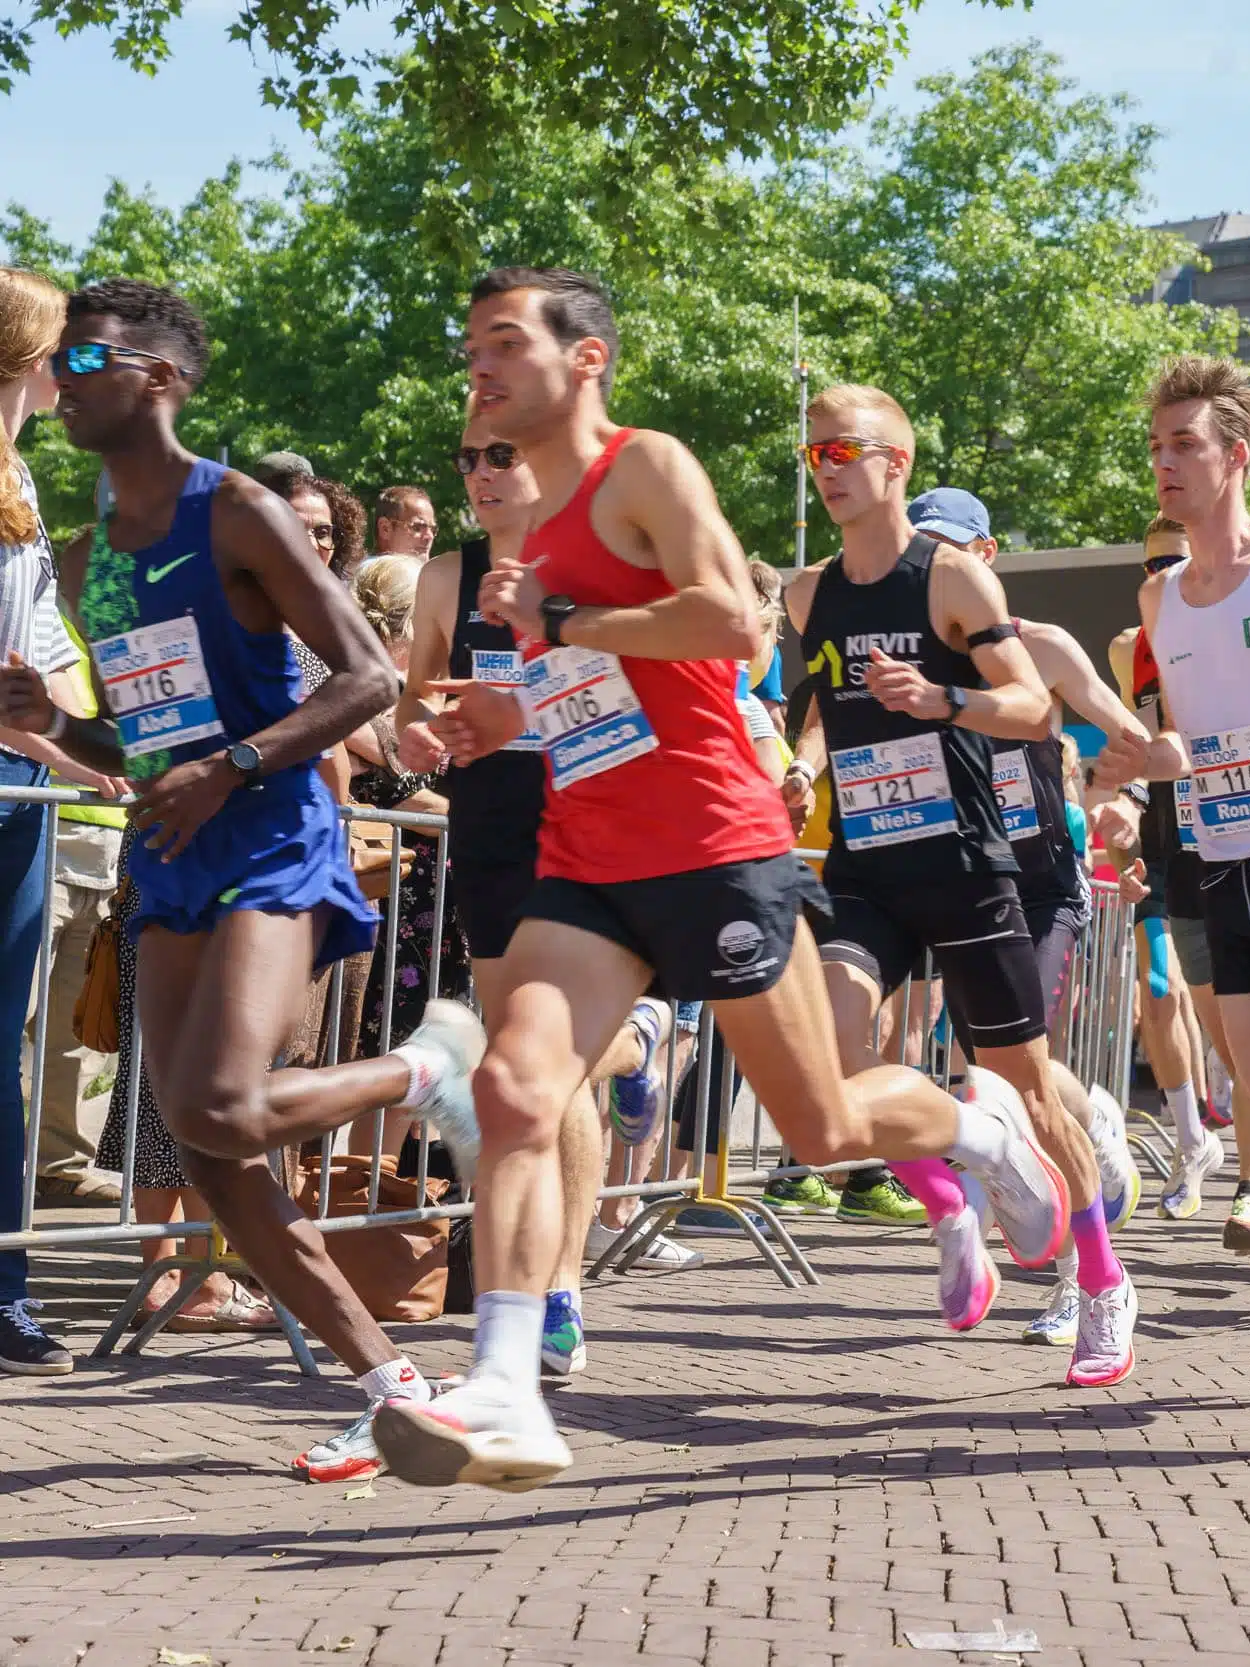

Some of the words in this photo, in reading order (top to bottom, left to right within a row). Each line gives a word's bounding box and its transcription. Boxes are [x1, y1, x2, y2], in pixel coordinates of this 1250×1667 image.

[475, 669, 523, 683] VENLOO
[132, 669, 176, 704] 116
[554, 689, 601, 730] 106
[992, 768, 1020, 781] 2022
[870, 776, 916, 805] 121
[1195, 777, 1208, 794] M
[869, 809, 925, 832] Niels
[1003, 815, 1021, 829] er
[1180, 809, 1192, 821] M
